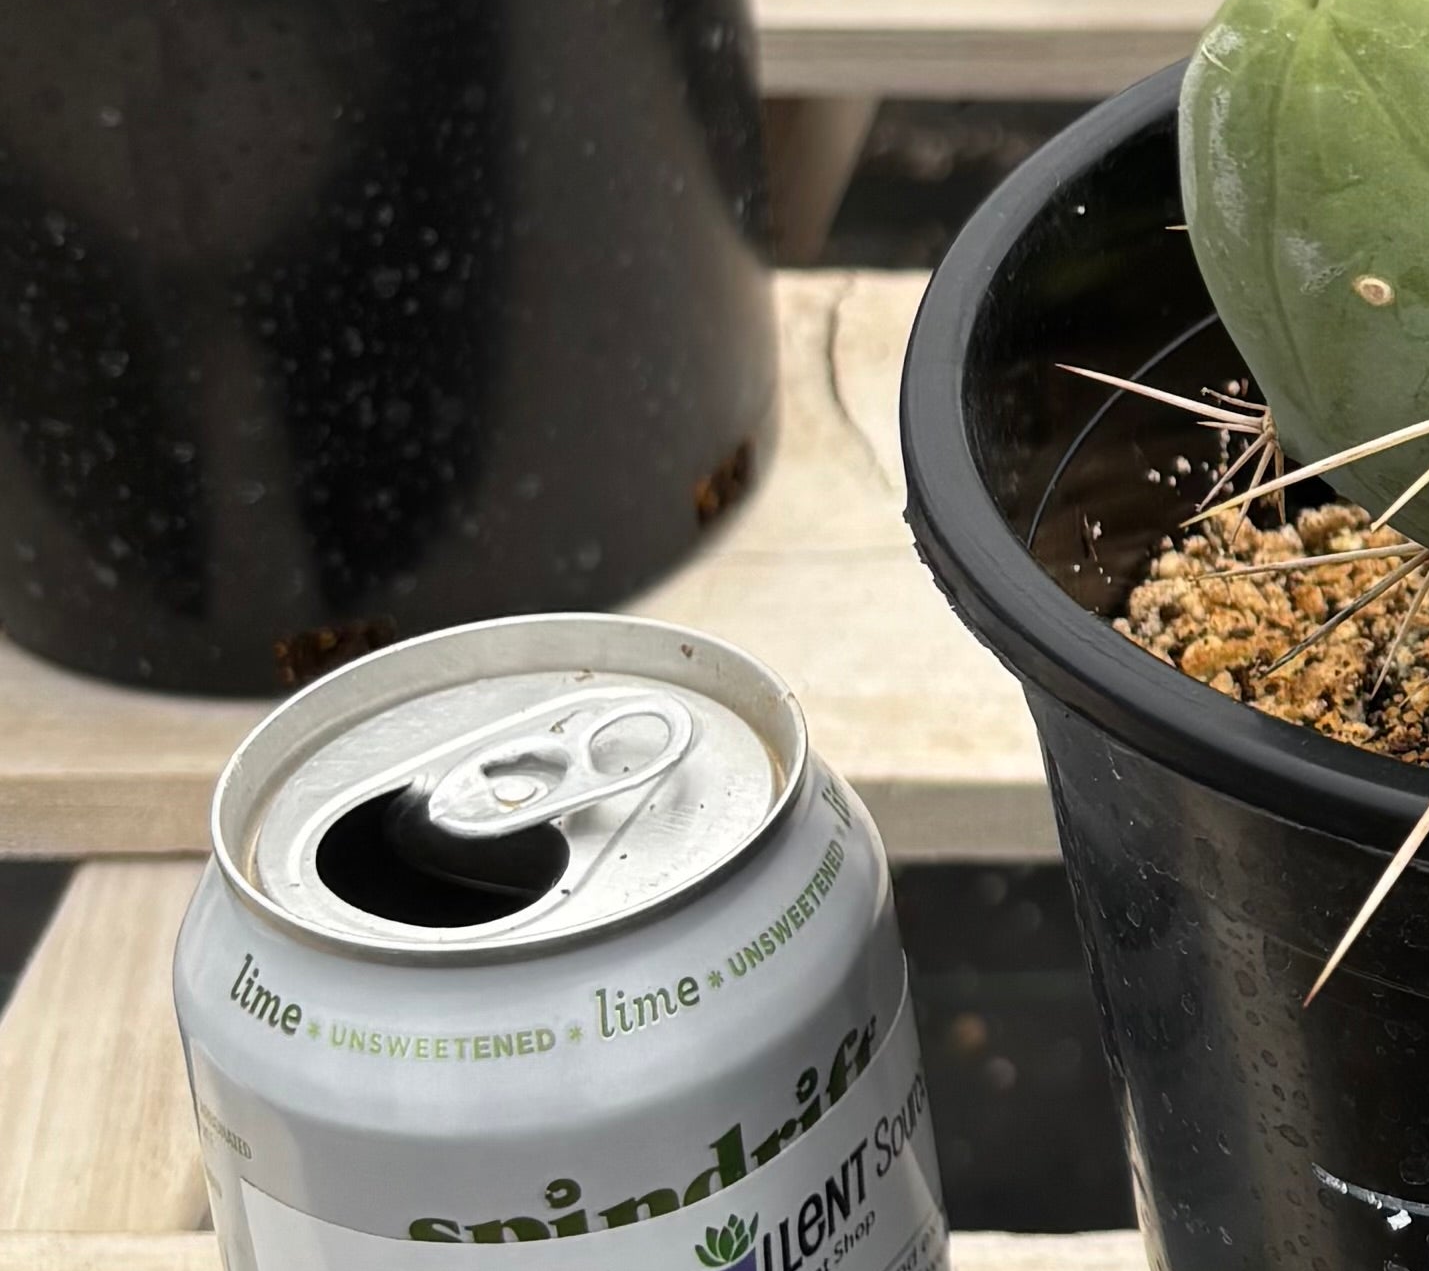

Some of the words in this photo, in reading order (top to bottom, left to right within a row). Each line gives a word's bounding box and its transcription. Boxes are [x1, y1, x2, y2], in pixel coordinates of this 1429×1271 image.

[230, 954, 302, 1035] lime
[330, 1024, 556, 1061] UNSWEETENED
[596, 976, 700, 1039] lime
[727, 838, 845, 978] UNSWEETENED
[834, 1210, 875, 1264] Shop
